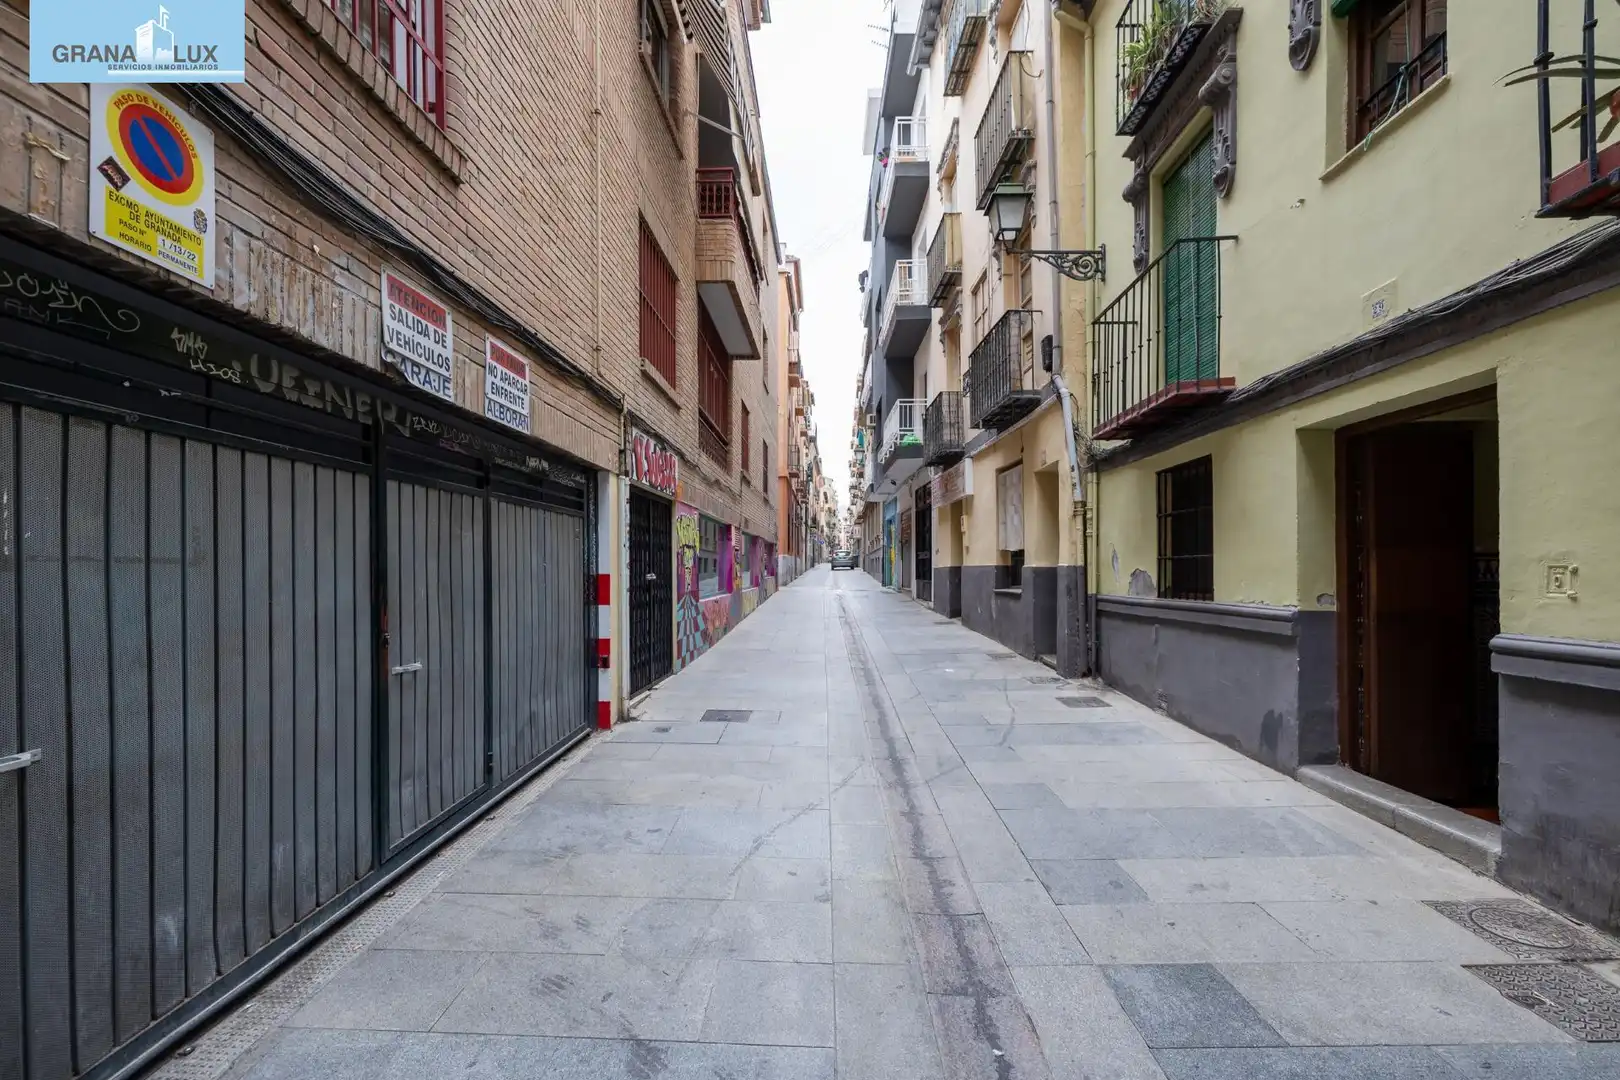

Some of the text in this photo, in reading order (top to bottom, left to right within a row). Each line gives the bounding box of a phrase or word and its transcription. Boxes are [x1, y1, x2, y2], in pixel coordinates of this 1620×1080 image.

[113, 93, 134, 110] PASO
[136, 93, 149, 104] DE
[118, 218, 138, 233] PASO
[129, 211, 182, 245] DE GRANADA
[144, 209, 202, 246] AYUNTAMIENTO
[118, 231, 152, 252] HORARIO
[157, 249, 198, 274] PERMANENTE
[389, 303, 448, 350] SALIDA DE
[386, 324, 451, 372] VEHÍCULOS
[488, 362, 528, 396] NO APARCAR
[491, 381, 525, 410] ENFRENTE
